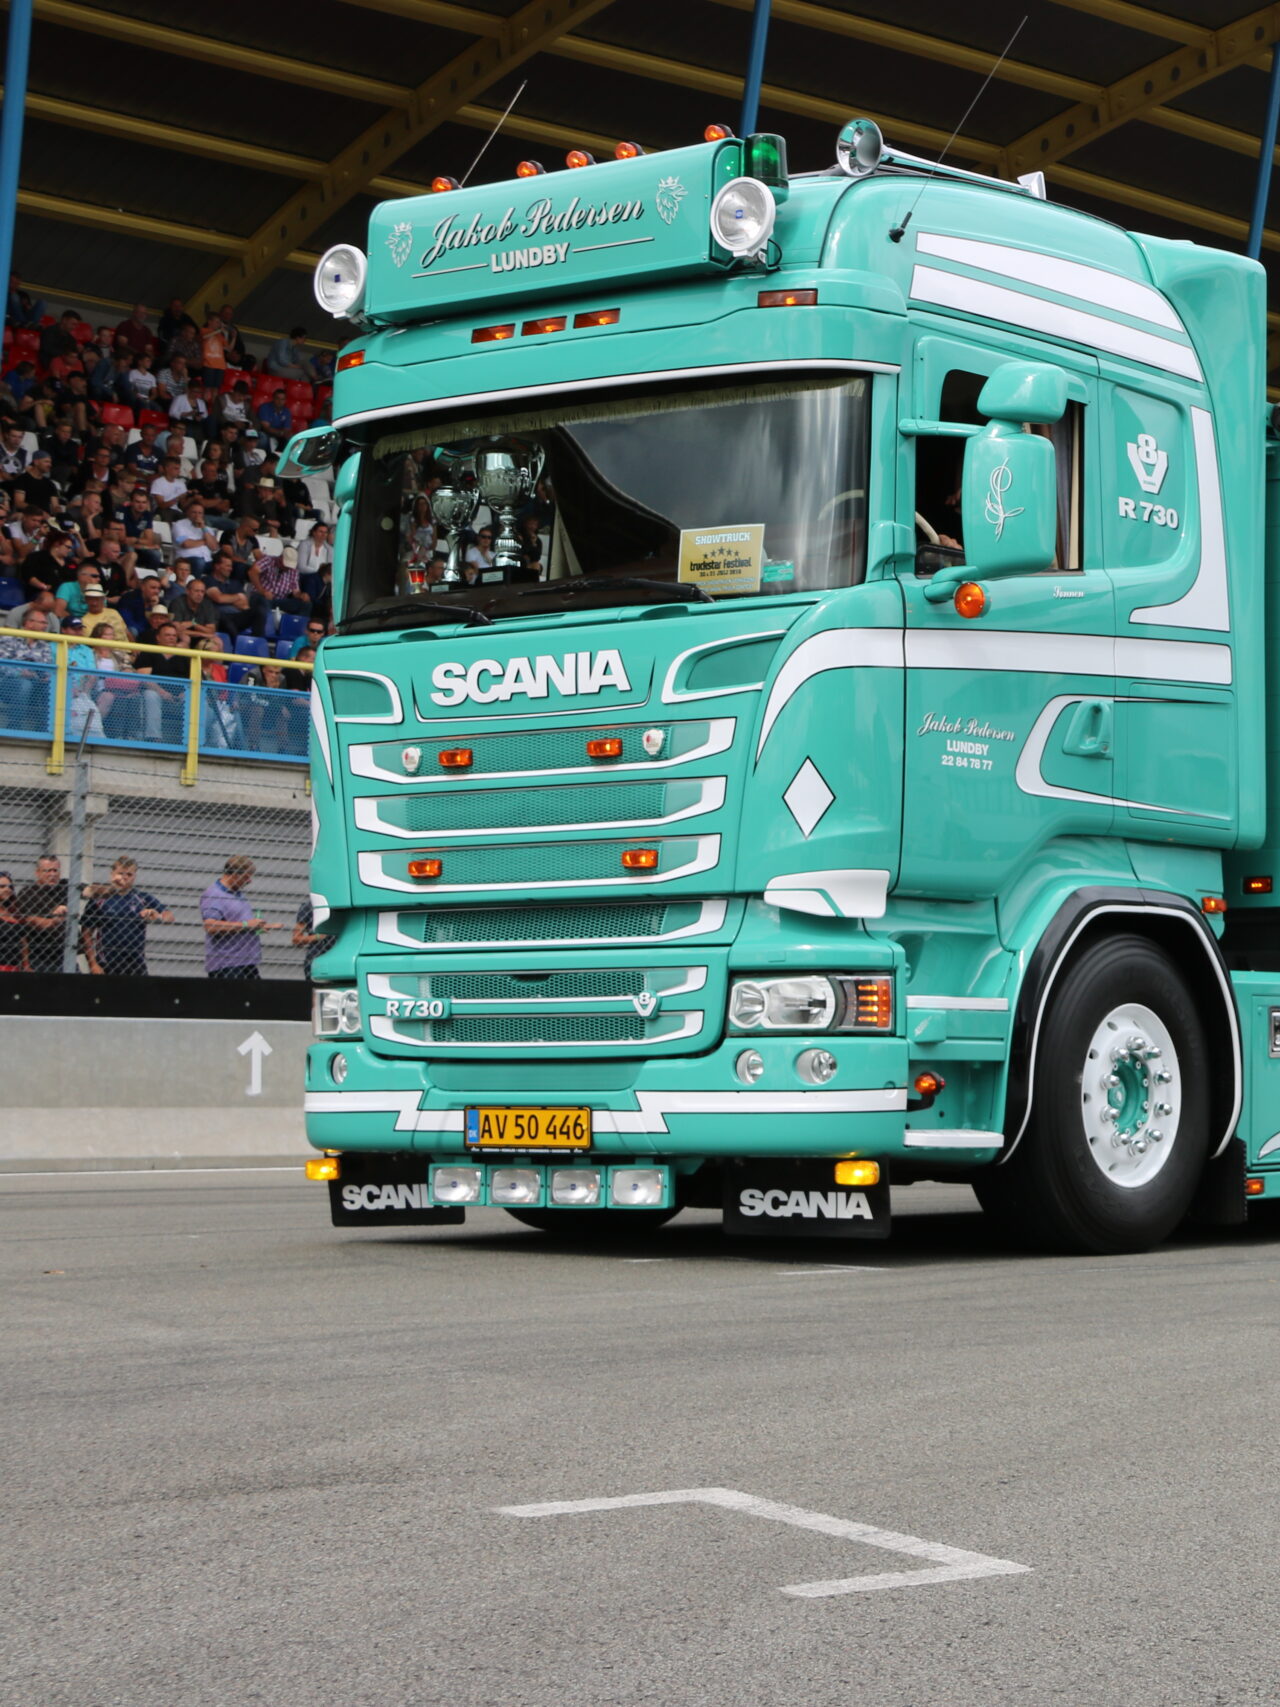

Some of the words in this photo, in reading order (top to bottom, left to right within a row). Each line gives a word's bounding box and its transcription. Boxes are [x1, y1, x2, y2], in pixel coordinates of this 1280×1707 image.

[420, 207, 518, 269] Jakob
[521, 196, 645, 238] Pedersen
[491, 242, 571, 273] LUNDBY
[1118, 496, 1137, 519] R
[1140, 501, 1179, 530] 730
[695, 532, 752, 545] SHOWTRUCK
[430, 649, 633, 707] SCANIA
[917, 712, 962, 736] Jakob
[964, 718, 1015, 741] Pedersen
[946, 739, 989, 756] LUNDBY
[941, 755, 954, 767] 22
[956, 756, 968, 768] 84
[969, 758, 981, 769] 78
[982, 759, 993, 771] 77
[386, 1000, 400, 1017] R
[403, 1000, 444, 1017] 730
[481, 1114, 508, 1139] AV
[514, 1114, 539, 1140] 50
[545, 1114, 585, 1140] 446
[342, 1183, 450, 1210] SCANI
[739, 1188, 874, 1220] SCANIA
